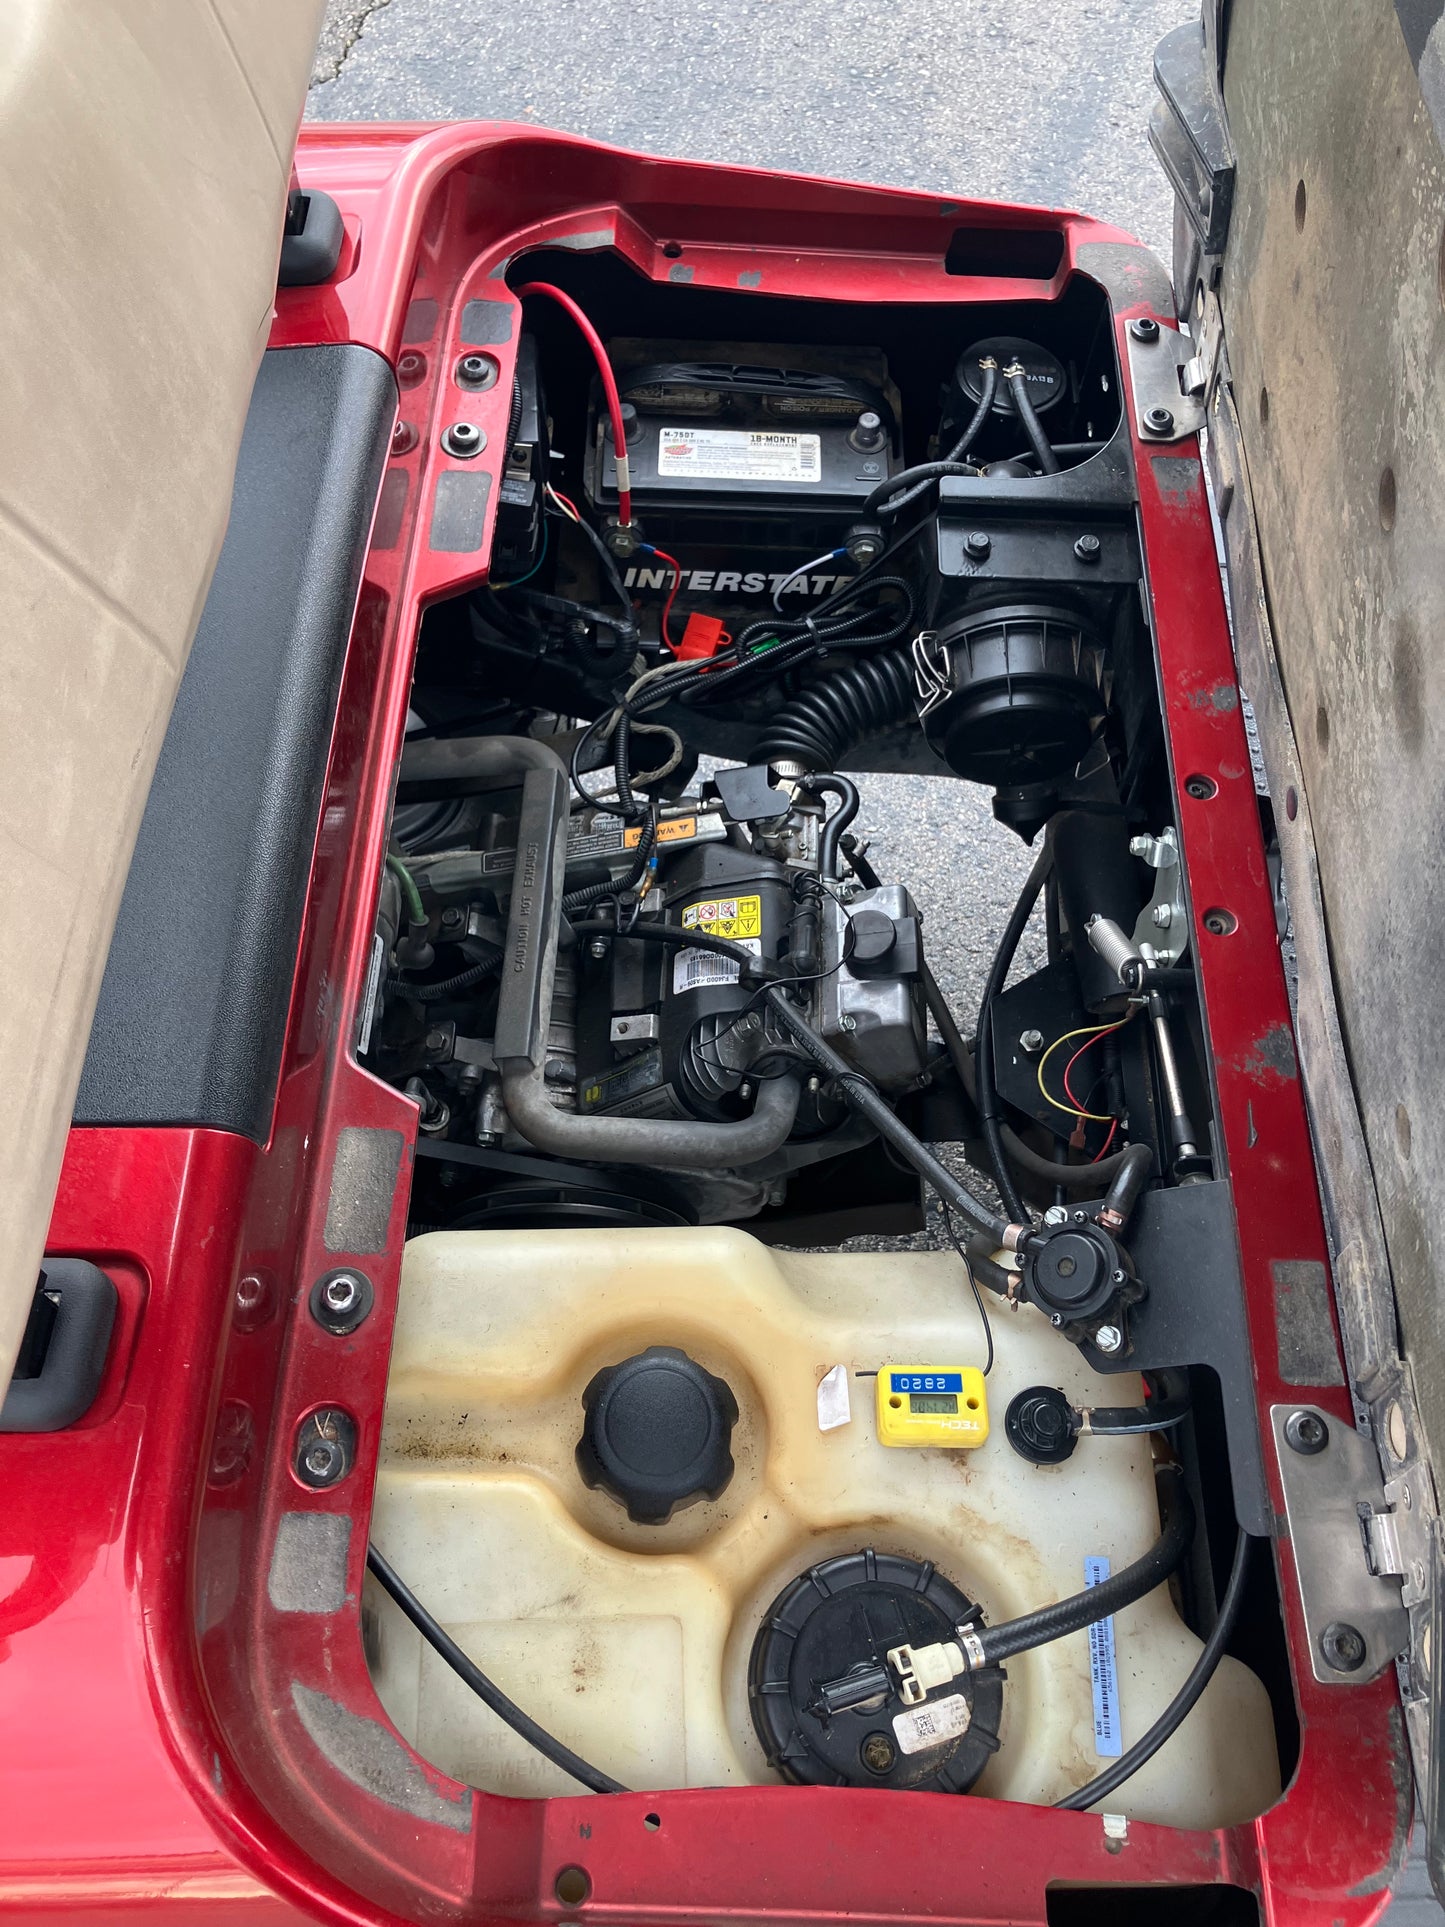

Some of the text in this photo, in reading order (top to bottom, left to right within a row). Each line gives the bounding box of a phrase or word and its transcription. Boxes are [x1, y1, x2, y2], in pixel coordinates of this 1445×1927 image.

[514, 842, 539, 973] CAUTION HOT EXHAUST
[941, 1420, 980, 1431] TECH
